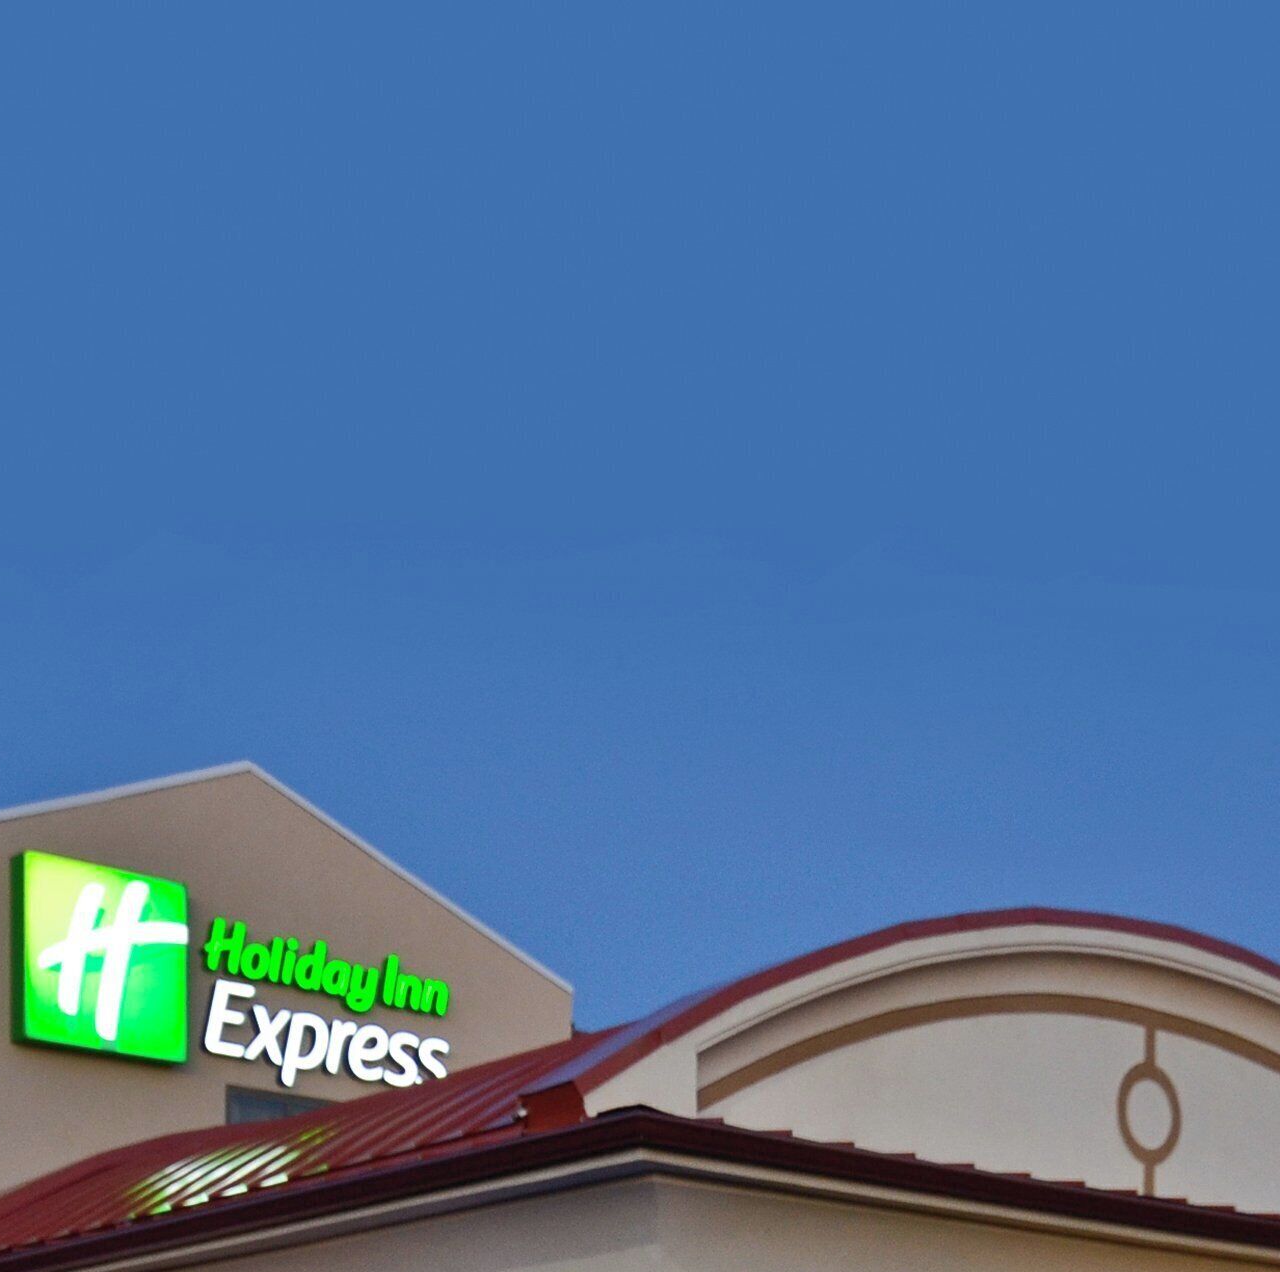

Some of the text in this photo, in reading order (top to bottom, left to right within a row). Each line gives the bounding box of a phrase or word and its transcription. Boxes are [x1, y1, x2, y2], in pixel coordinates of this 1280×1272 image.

[39, 880, 189, 1042] H
[205, 917, 449, 1016] Holiday Inn
[205, 979, 450, 1087] Express
